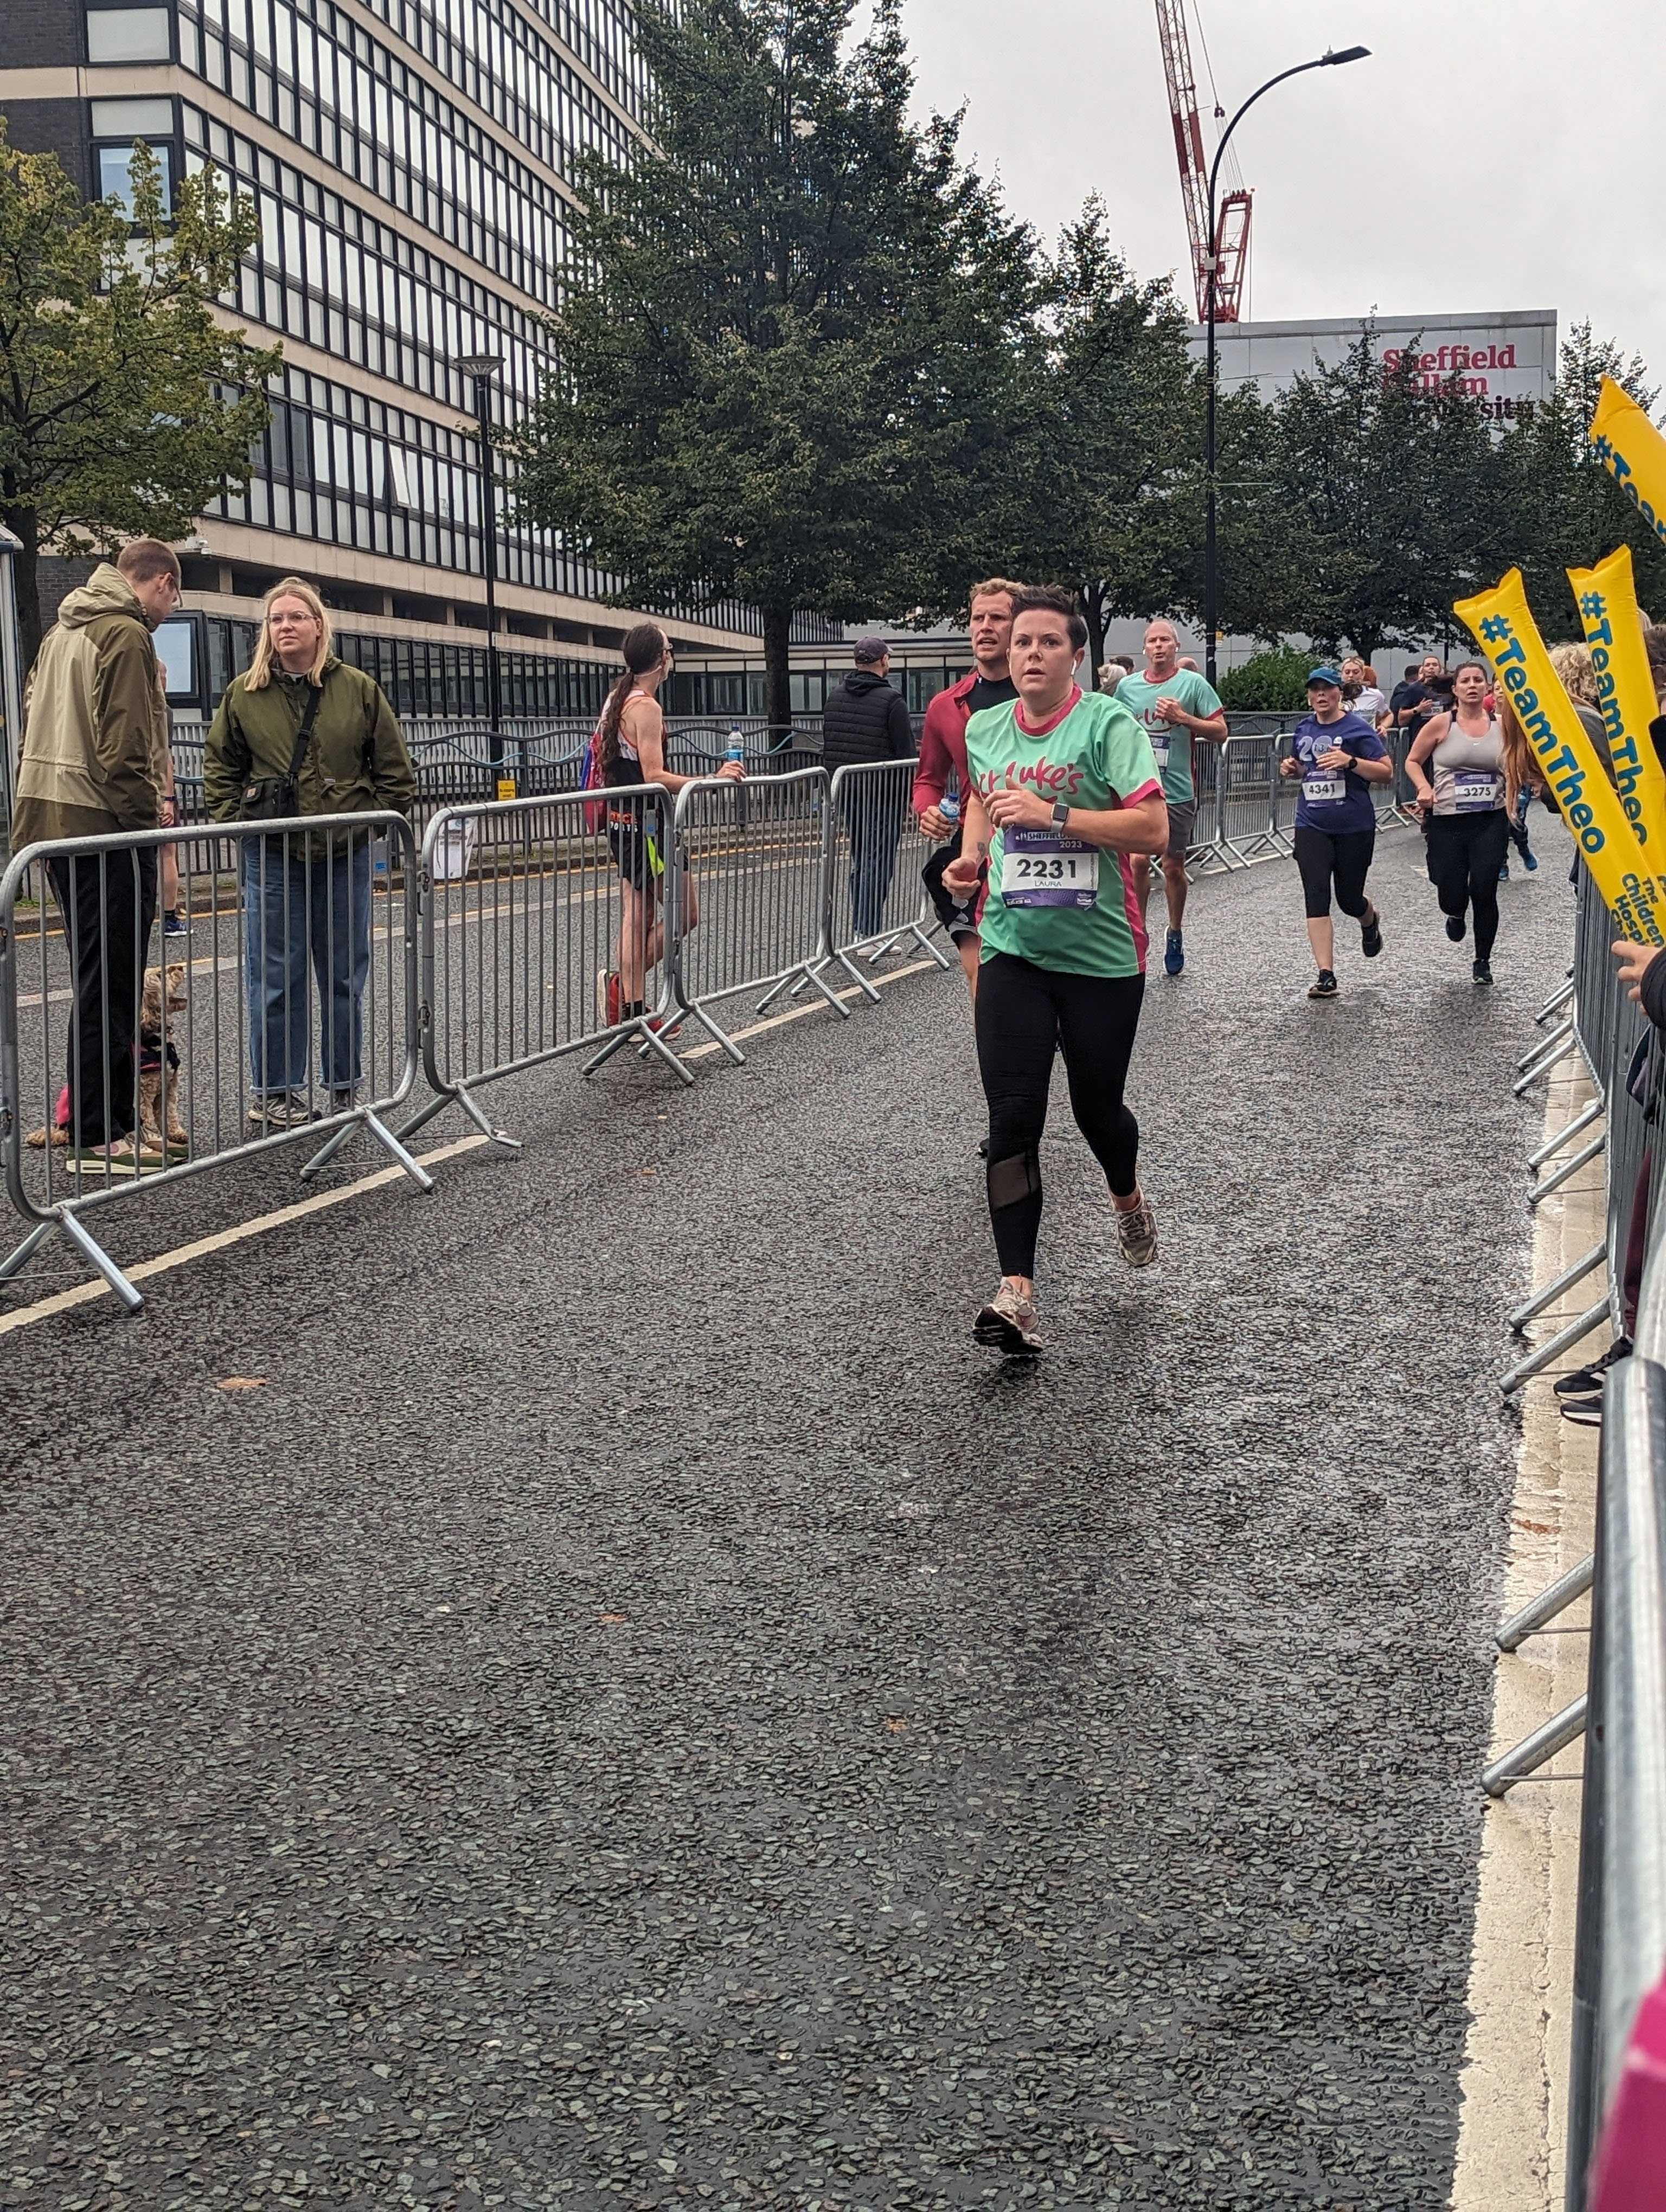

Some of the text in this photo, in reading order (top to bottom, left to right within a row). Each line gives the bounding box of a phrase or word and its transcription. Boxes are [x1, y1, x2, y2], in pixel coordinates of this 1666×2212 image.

[1479, 613, 1605, 853] #TeamTheo
[1309, 783, 1335, 794] 4341
[1464, 787, 1491, 797] 3275
[1016, 859, 1077, 879] 2231
[1642, 877, 1659, 904] The
